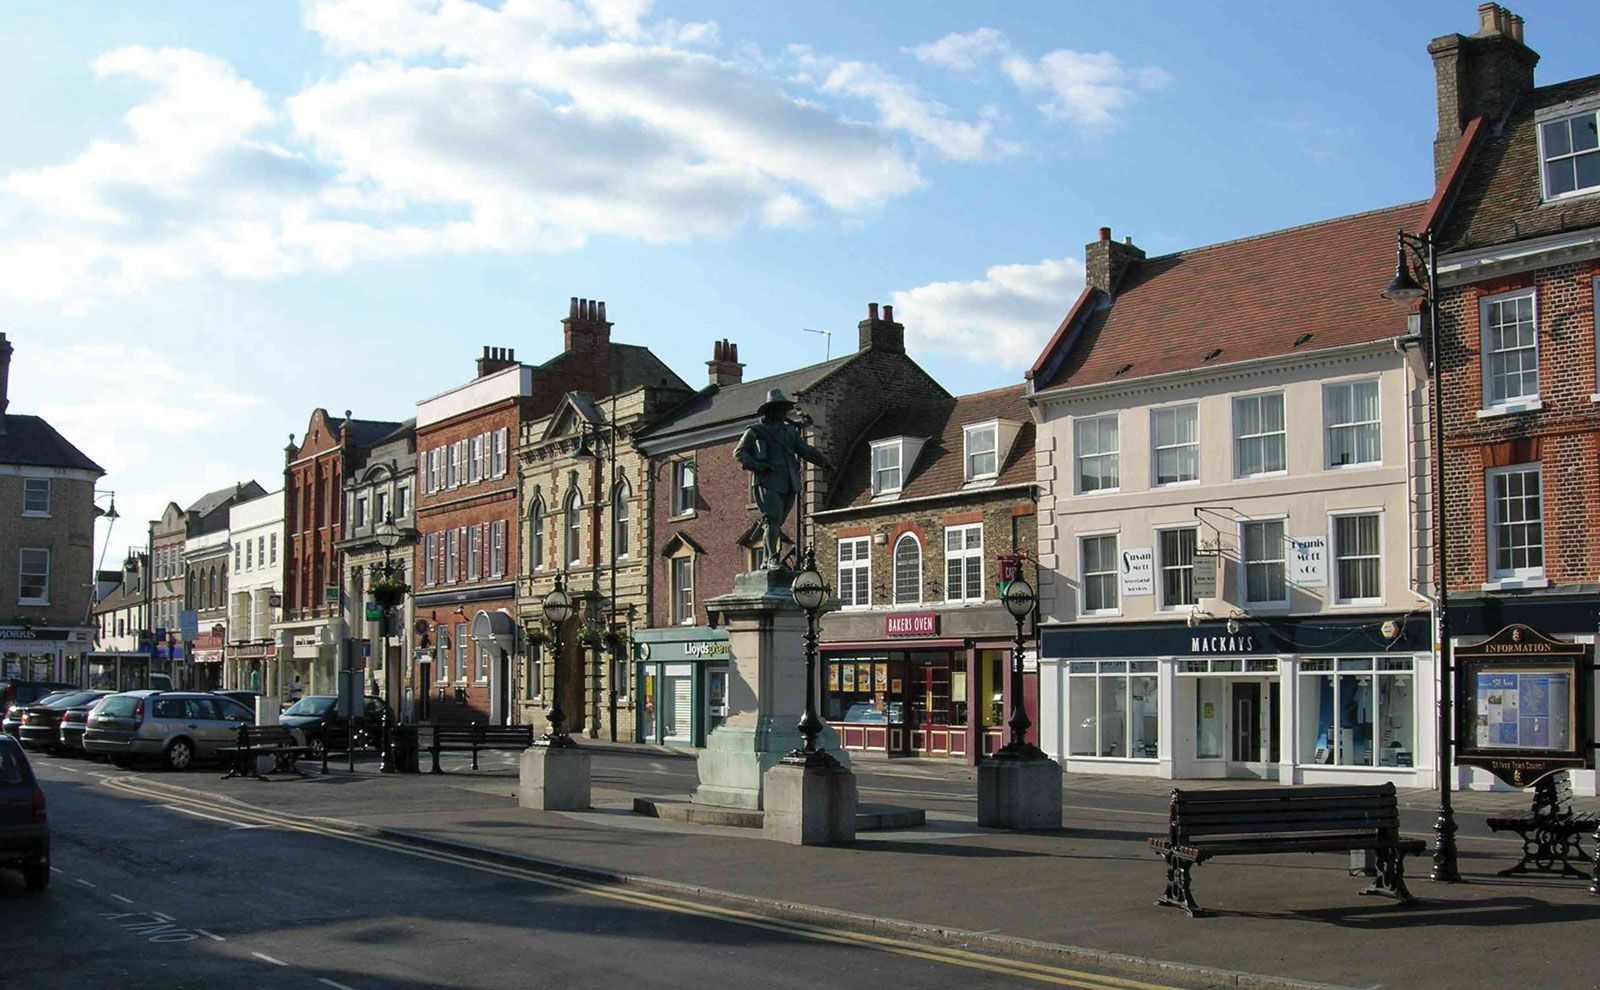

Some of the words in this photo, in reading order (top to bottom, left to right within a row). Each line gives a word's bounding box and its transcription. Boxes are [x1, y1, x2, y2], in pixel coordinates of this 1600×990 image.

[888, 618, 912, 632] BAKERS
[914, 616, 933, 631] OVEN
[1191, 636, 1253, 652] MACKAYS
[1485, 643, 1552, 653] INFORMATION
